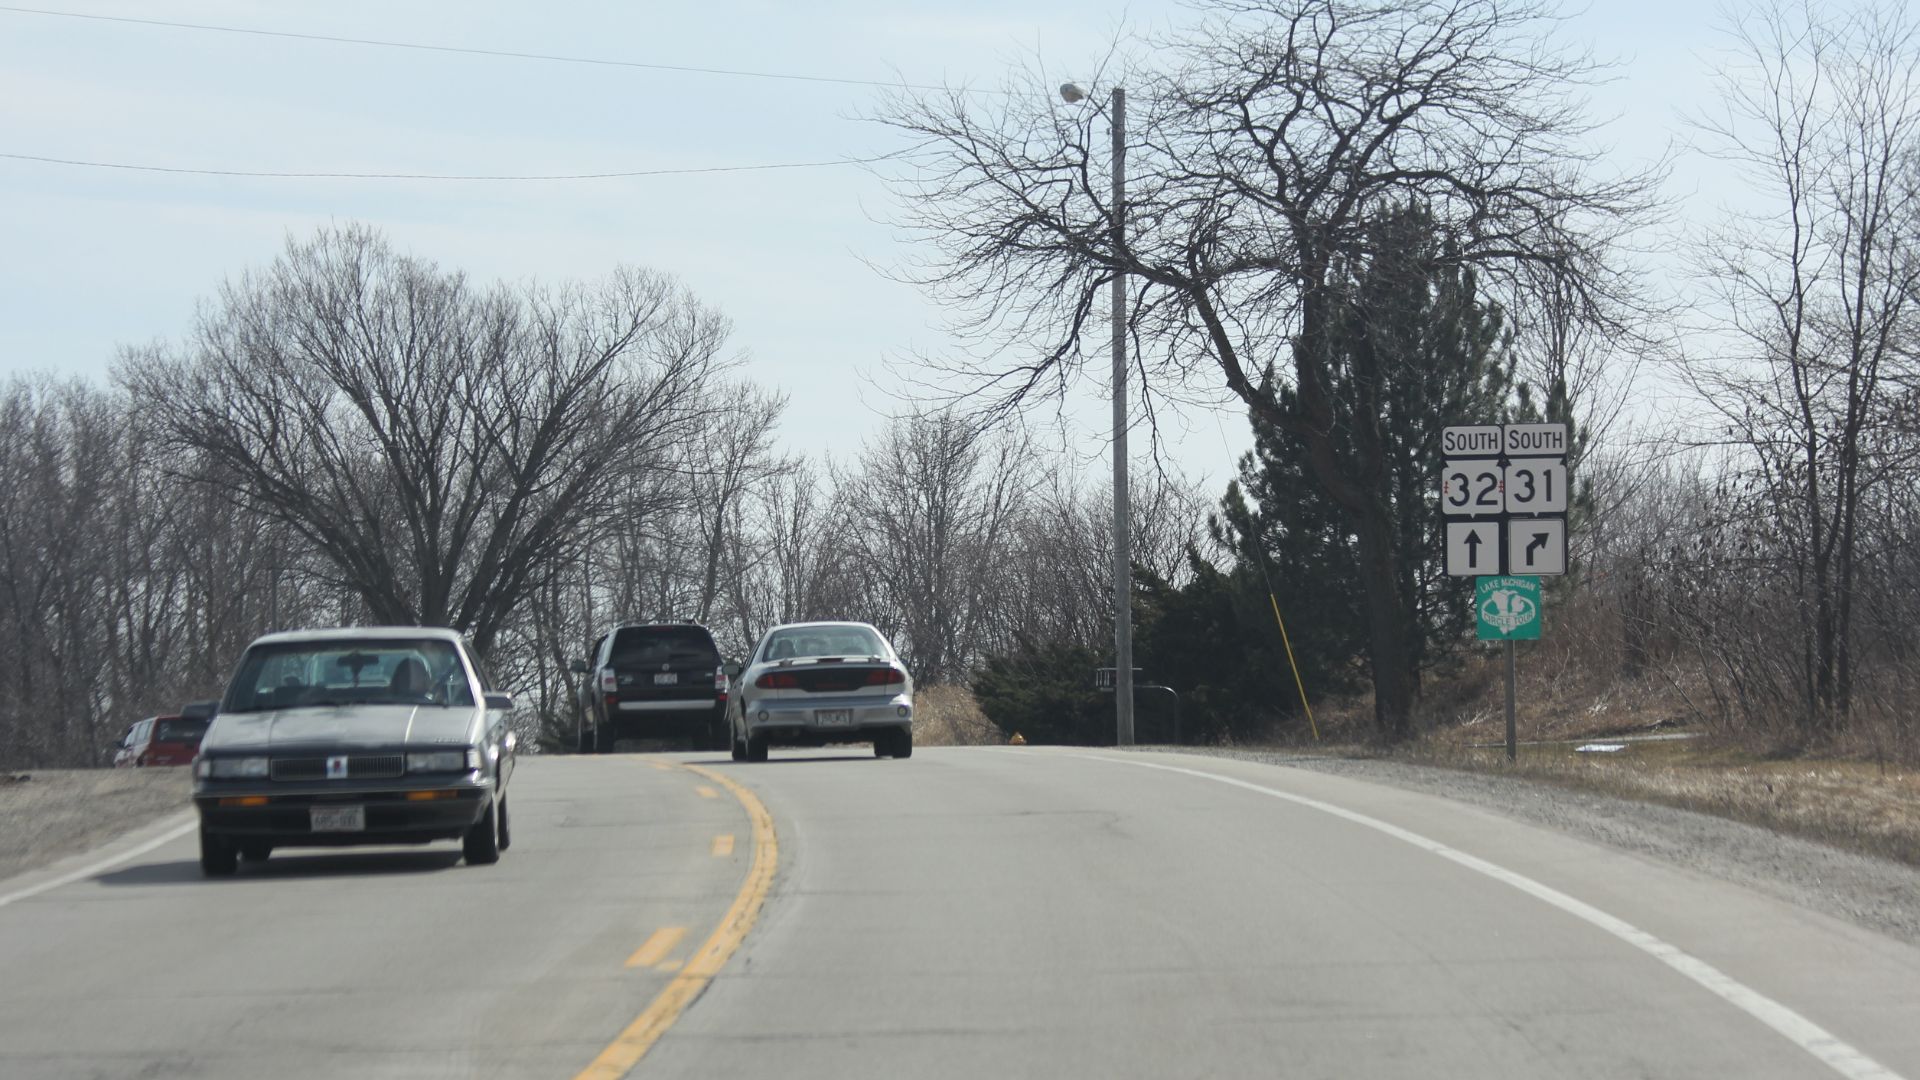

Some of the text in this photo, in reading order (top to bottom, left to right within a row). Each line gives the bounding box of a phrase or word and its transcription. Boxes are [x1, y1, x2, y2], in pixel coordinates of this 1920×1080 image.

[1445, 431, 1498, 451] SOUTH
[1509, 430, 1563, 449] SOUTH
[1448, 472, 1498, 507] 32
[1514, 469, 1552, 503] 31
[1480, 578, 1536, 594] LAKE MICHIGAN
[1484, 612, 1534, 625] CIRCLE TOUR
